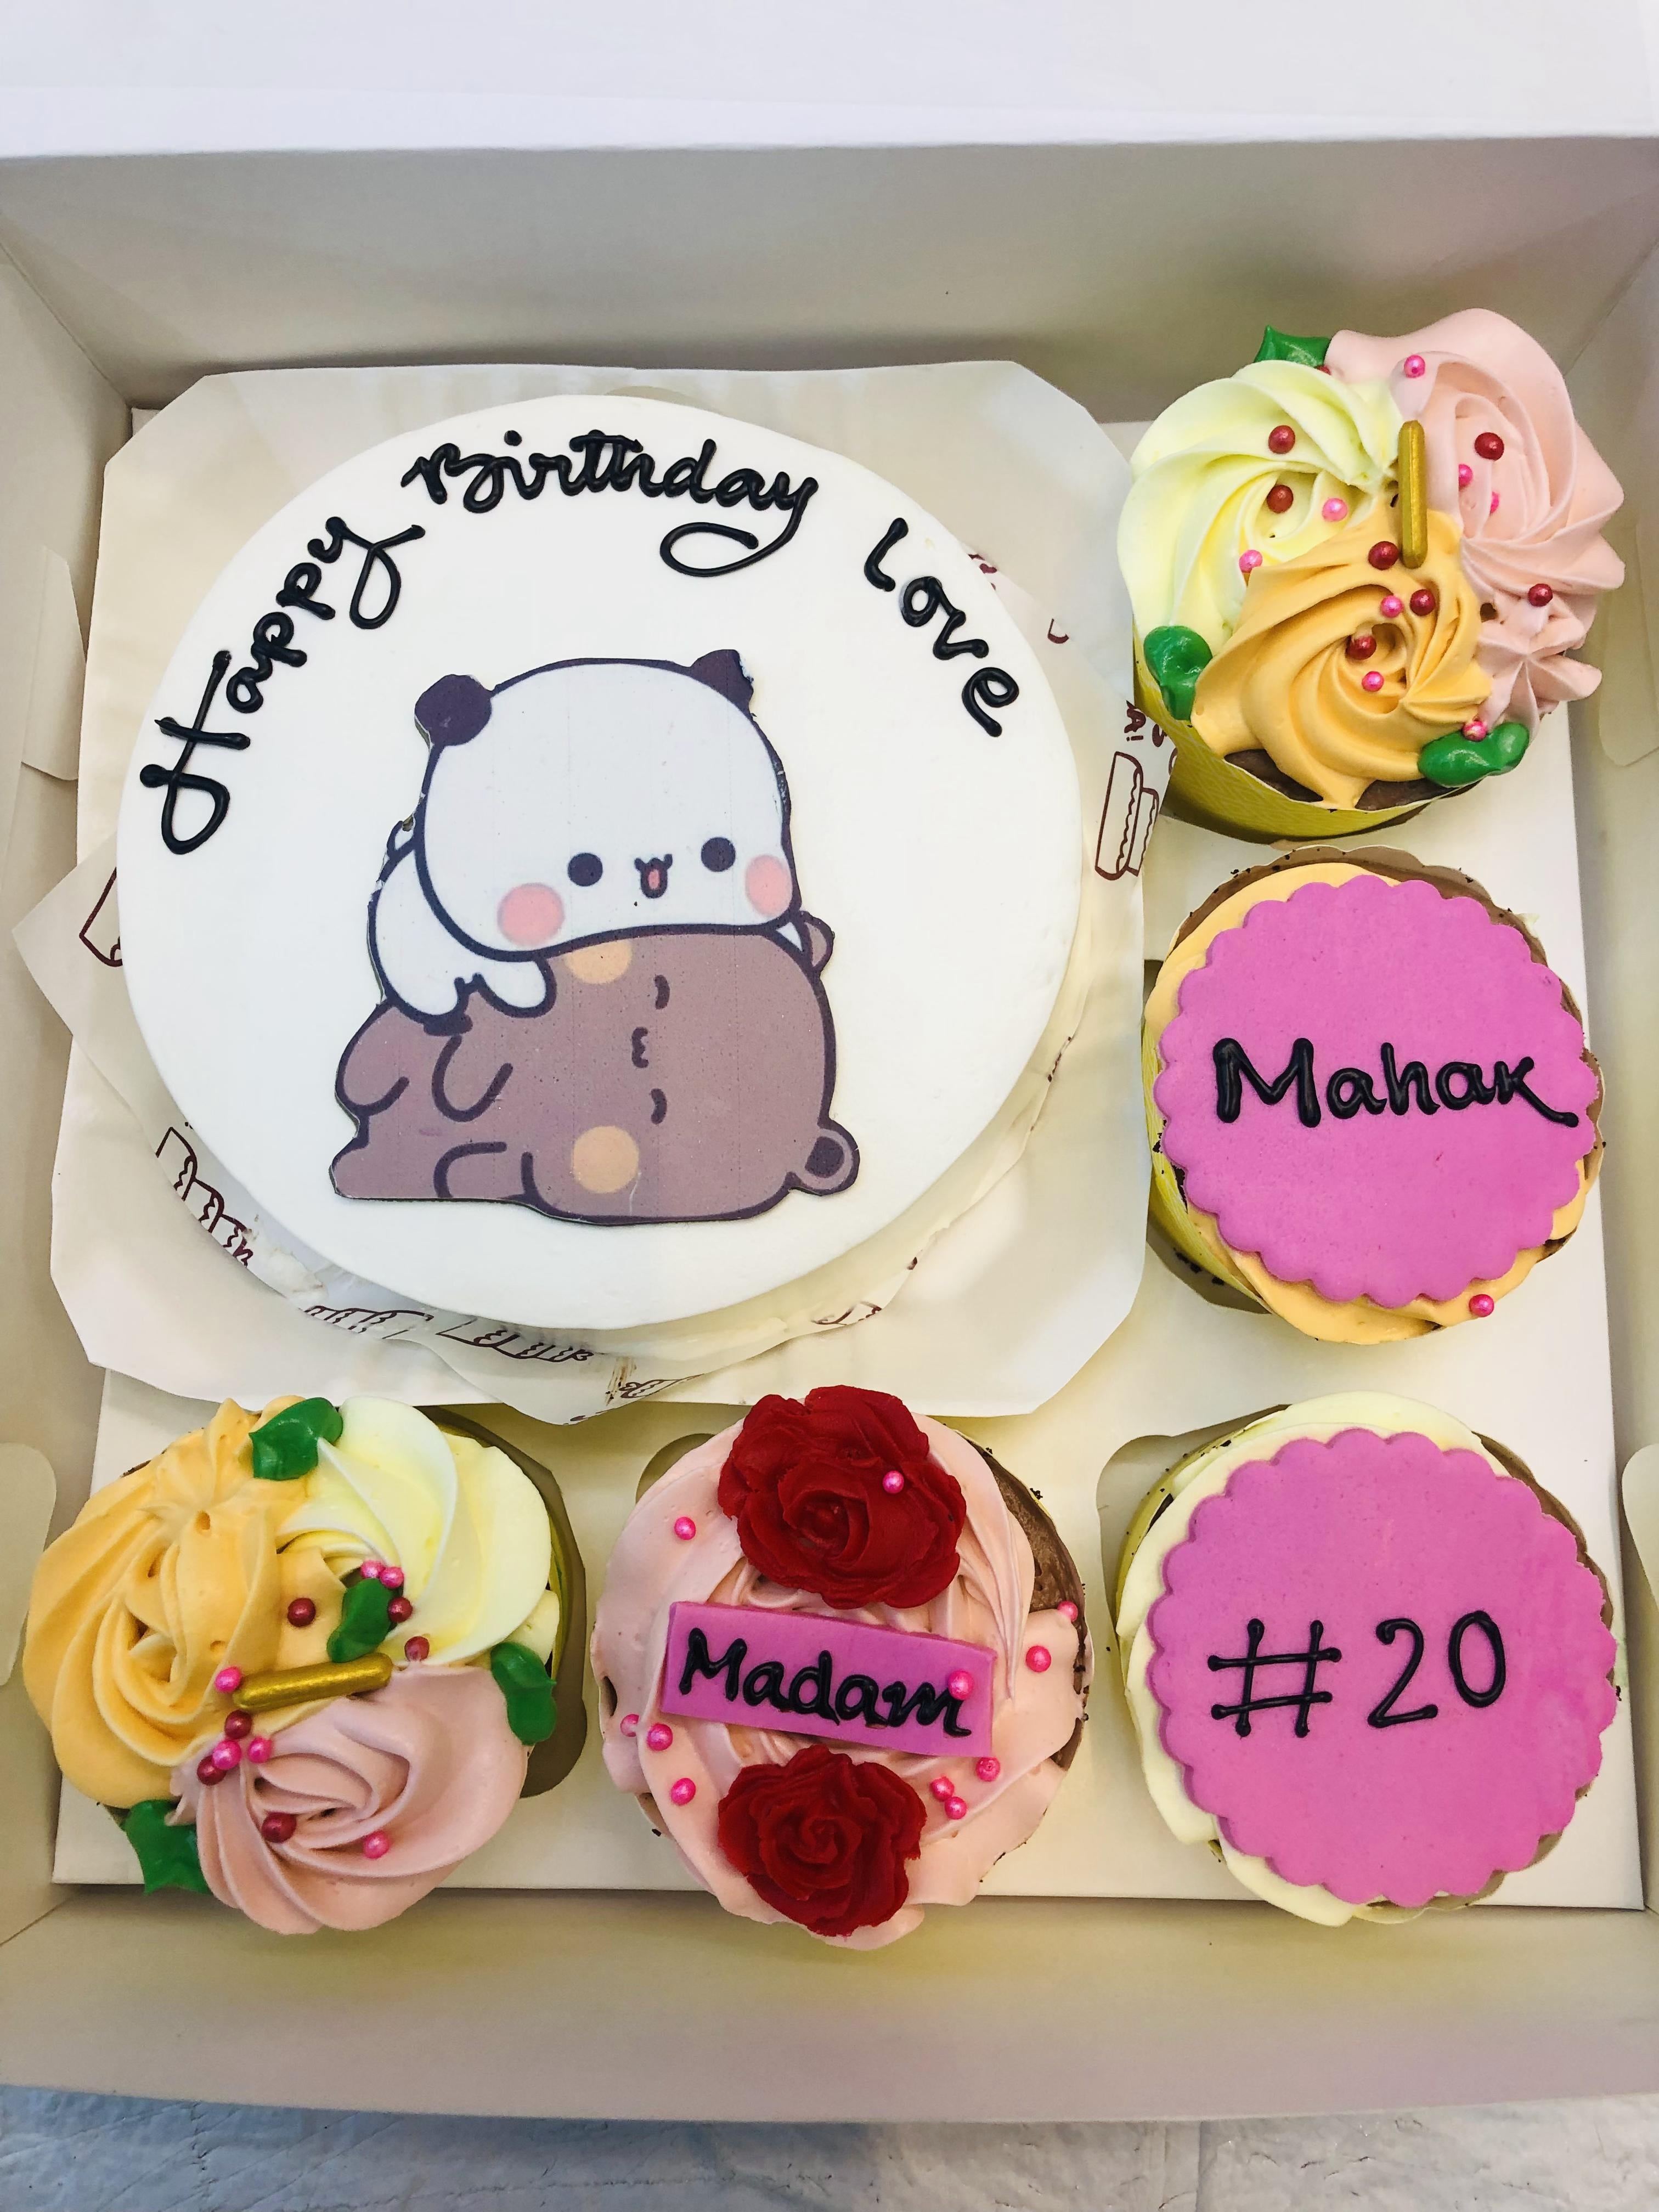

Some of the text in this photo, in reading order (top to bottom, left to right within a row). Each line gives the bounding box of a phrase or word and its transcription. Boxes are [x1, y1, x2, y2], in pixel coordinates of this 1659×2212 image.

[139, 516, 426, 855] Happy
[400, 428, 820, 578] Birthday
[678, 1627, 972, 1738] Madam
